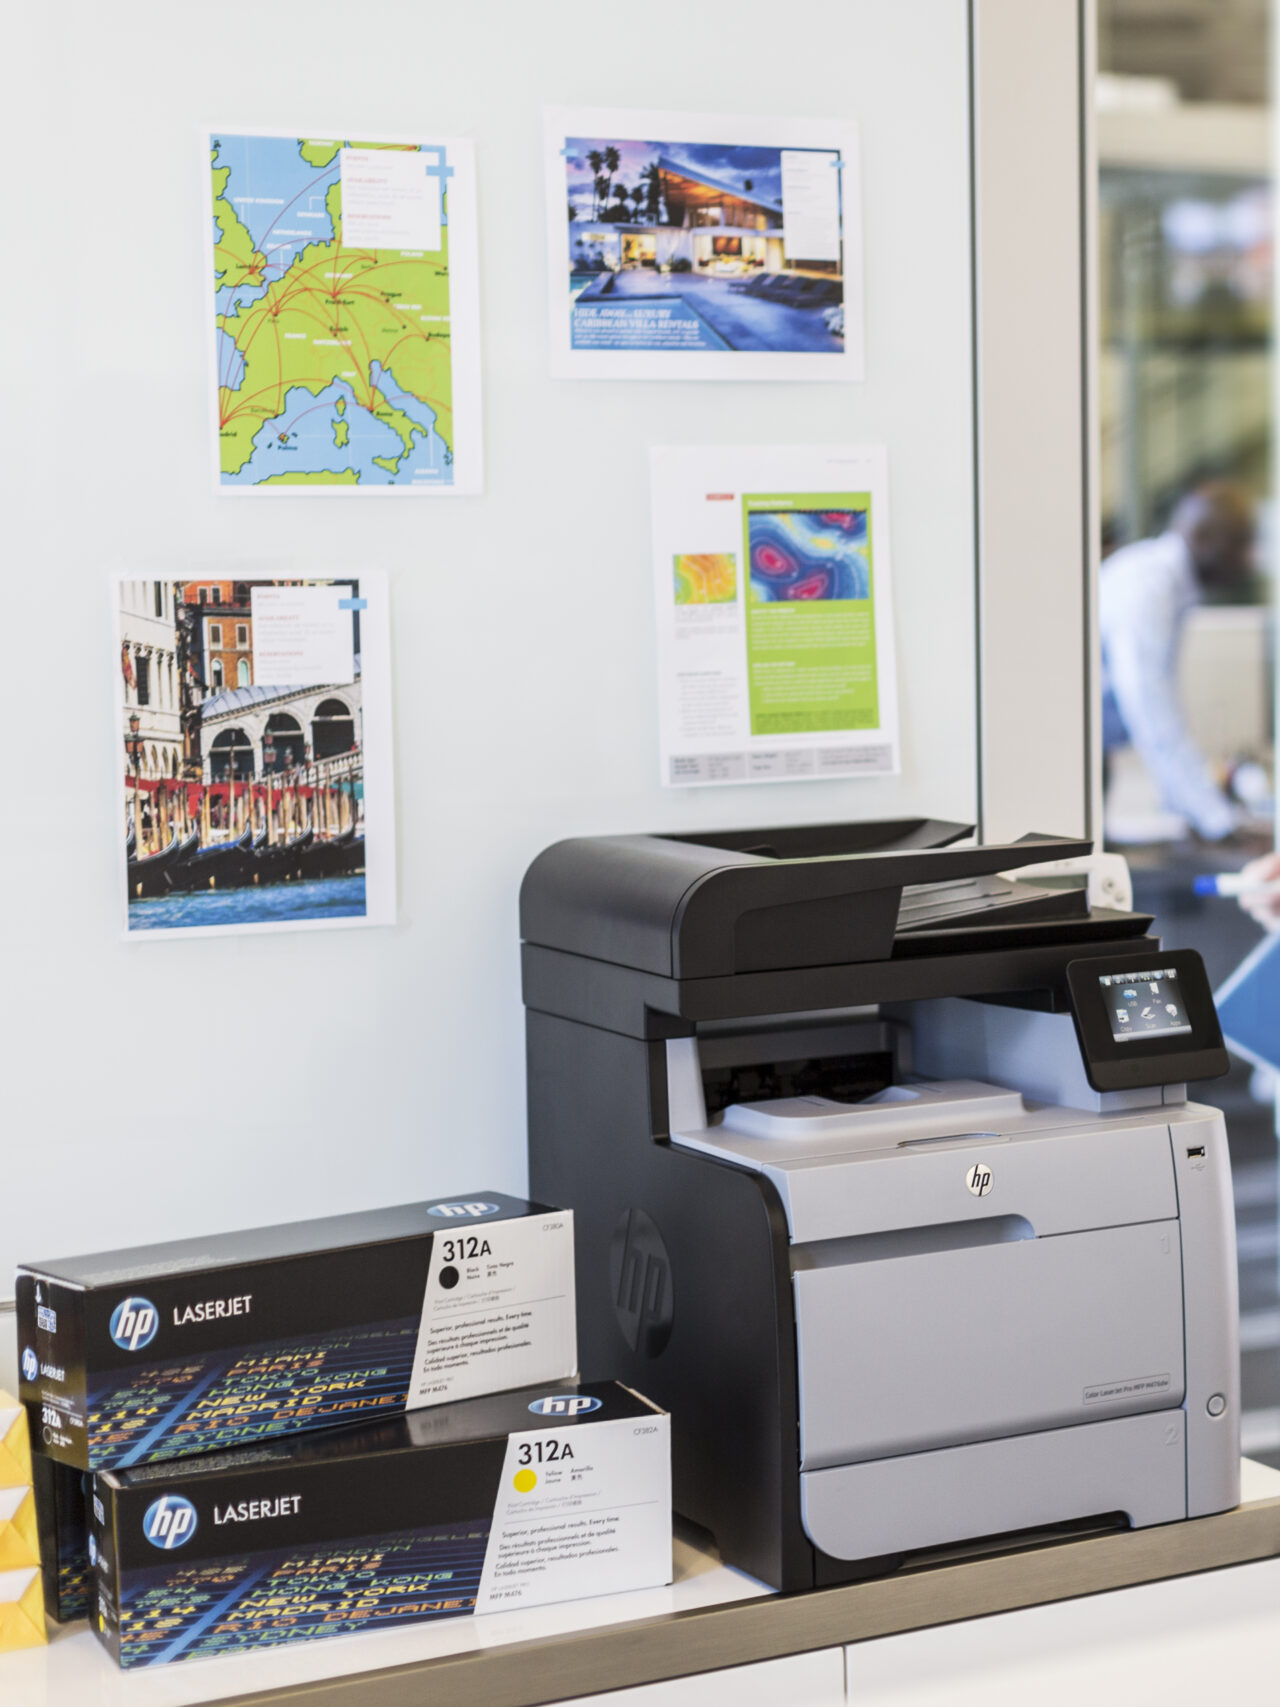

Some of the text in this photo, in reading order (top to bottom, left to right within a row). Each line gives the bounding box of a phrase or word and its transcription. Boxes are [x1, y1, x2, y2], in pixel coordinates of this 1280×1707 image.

[970, 1164, 991, 1197] hp
[435, 1202, 491, 1217] hp
[443, 1236, 492, 1262] 312A
[173, 1294, 253, 1326] LASERJET
[114, 1298, 155, 1350] hp
[454, 1318, 487, 1331] professional
[23, 1348, 36, 1381] hp
[227, 1359, 324, 1377] PARIS
[235, 1351, 327, 1368] MIAMI
[208, 1368, 387, 1397] HONG KONG
[222, 1368, 319, 1385] TOKYO
[196, 1379, 367, 1409] NEW YORK
[542, 1396, 592, 1416] hp
[42, 1406, 62, 1429] 312A
[186, 1395, 323, 1421] MADRID
[174, 1416, 250, 1434] RIO
[518, 1440, 574, 1465] 312A
[149, 1495, 193, 1549] hp
[213, 1495, 302, 1525] LASERJET
[530, 1523, 566, 1536] professional
[589, 1518, 606, 1527] Every
[271, 1561, 382, 1577] PARIS
[282, 1553, 386, 1569] MIAMI
[252, 1572, 453, 1599] HONG KONG
[266, 1571, 376, 1588] TOKYO
[239, 1583, 430, 1610] NEW YORK
[227, 1598, 380, 1622] MADRID
[213, 1616, 297, 1635] RIO
